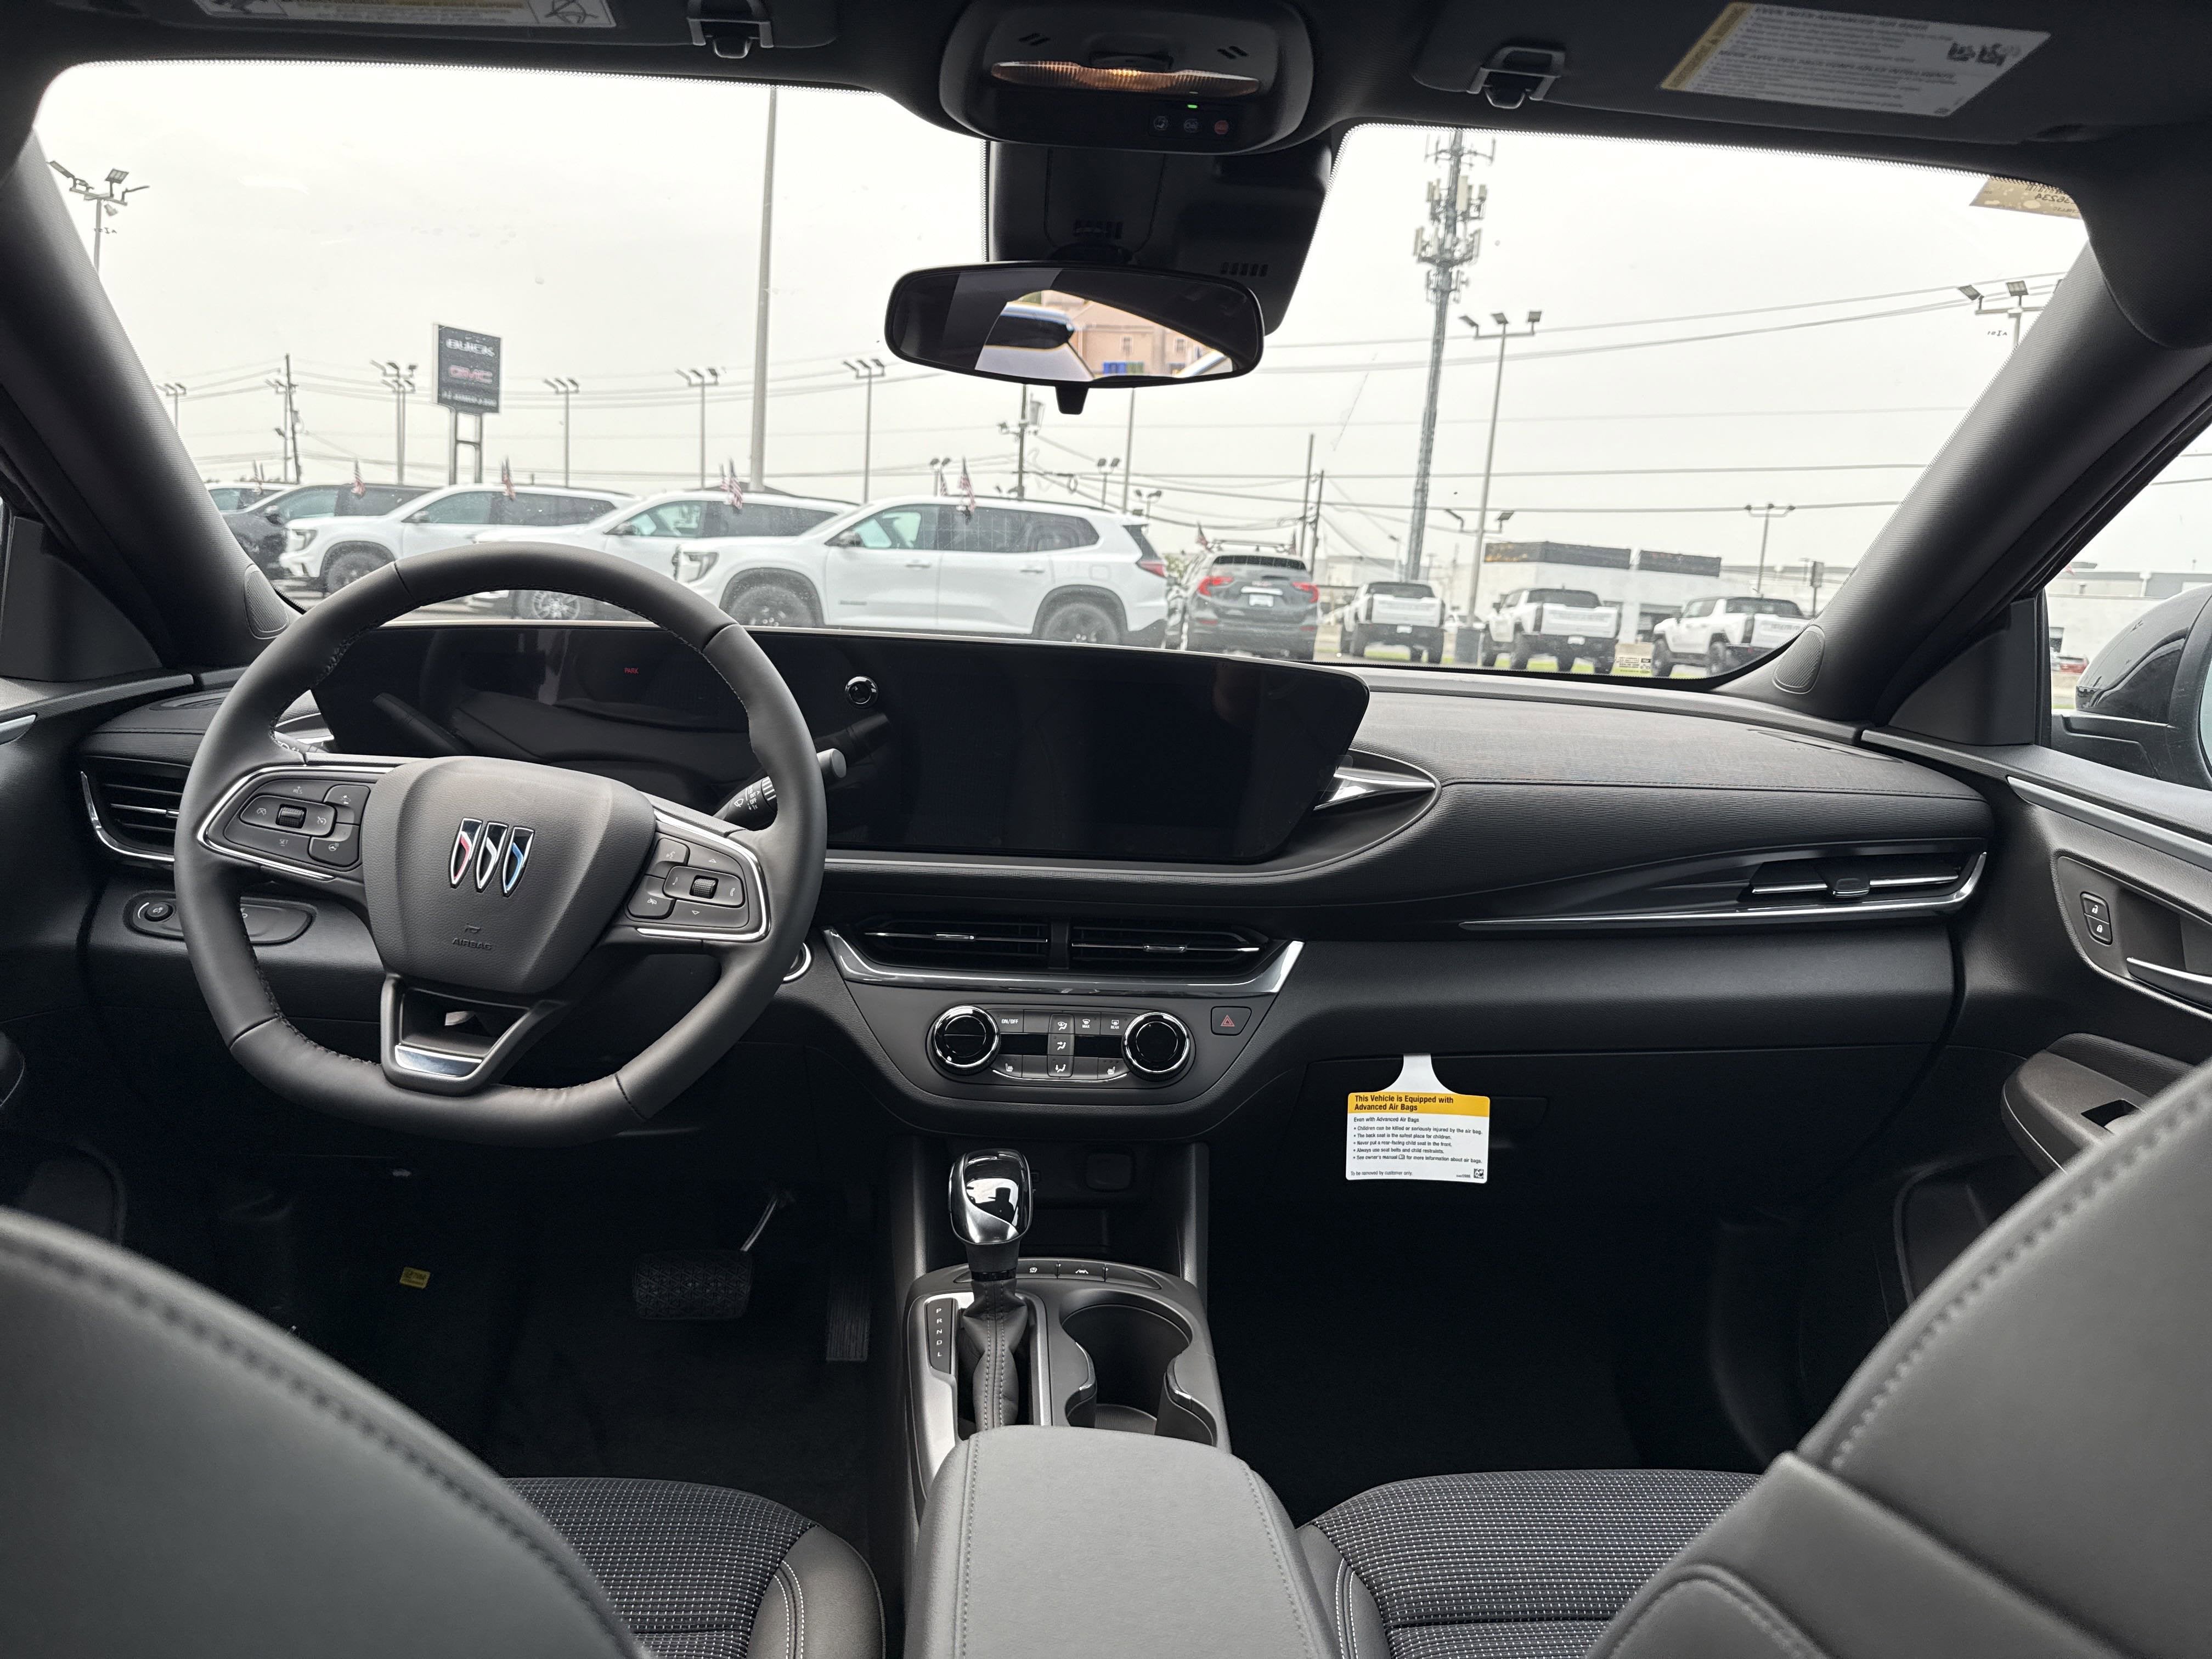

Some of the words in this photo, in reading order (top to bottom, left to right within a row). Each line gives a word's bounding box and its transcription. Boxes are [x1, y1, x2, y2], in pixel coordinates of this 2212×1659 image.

[445, 338, 495, 357] BUICK
[452, 938, 492, 951] AIRBAG
[1404, 1095, 1436, 1104] Equipped
[1401, 1103, 1418, 1112] Bags
